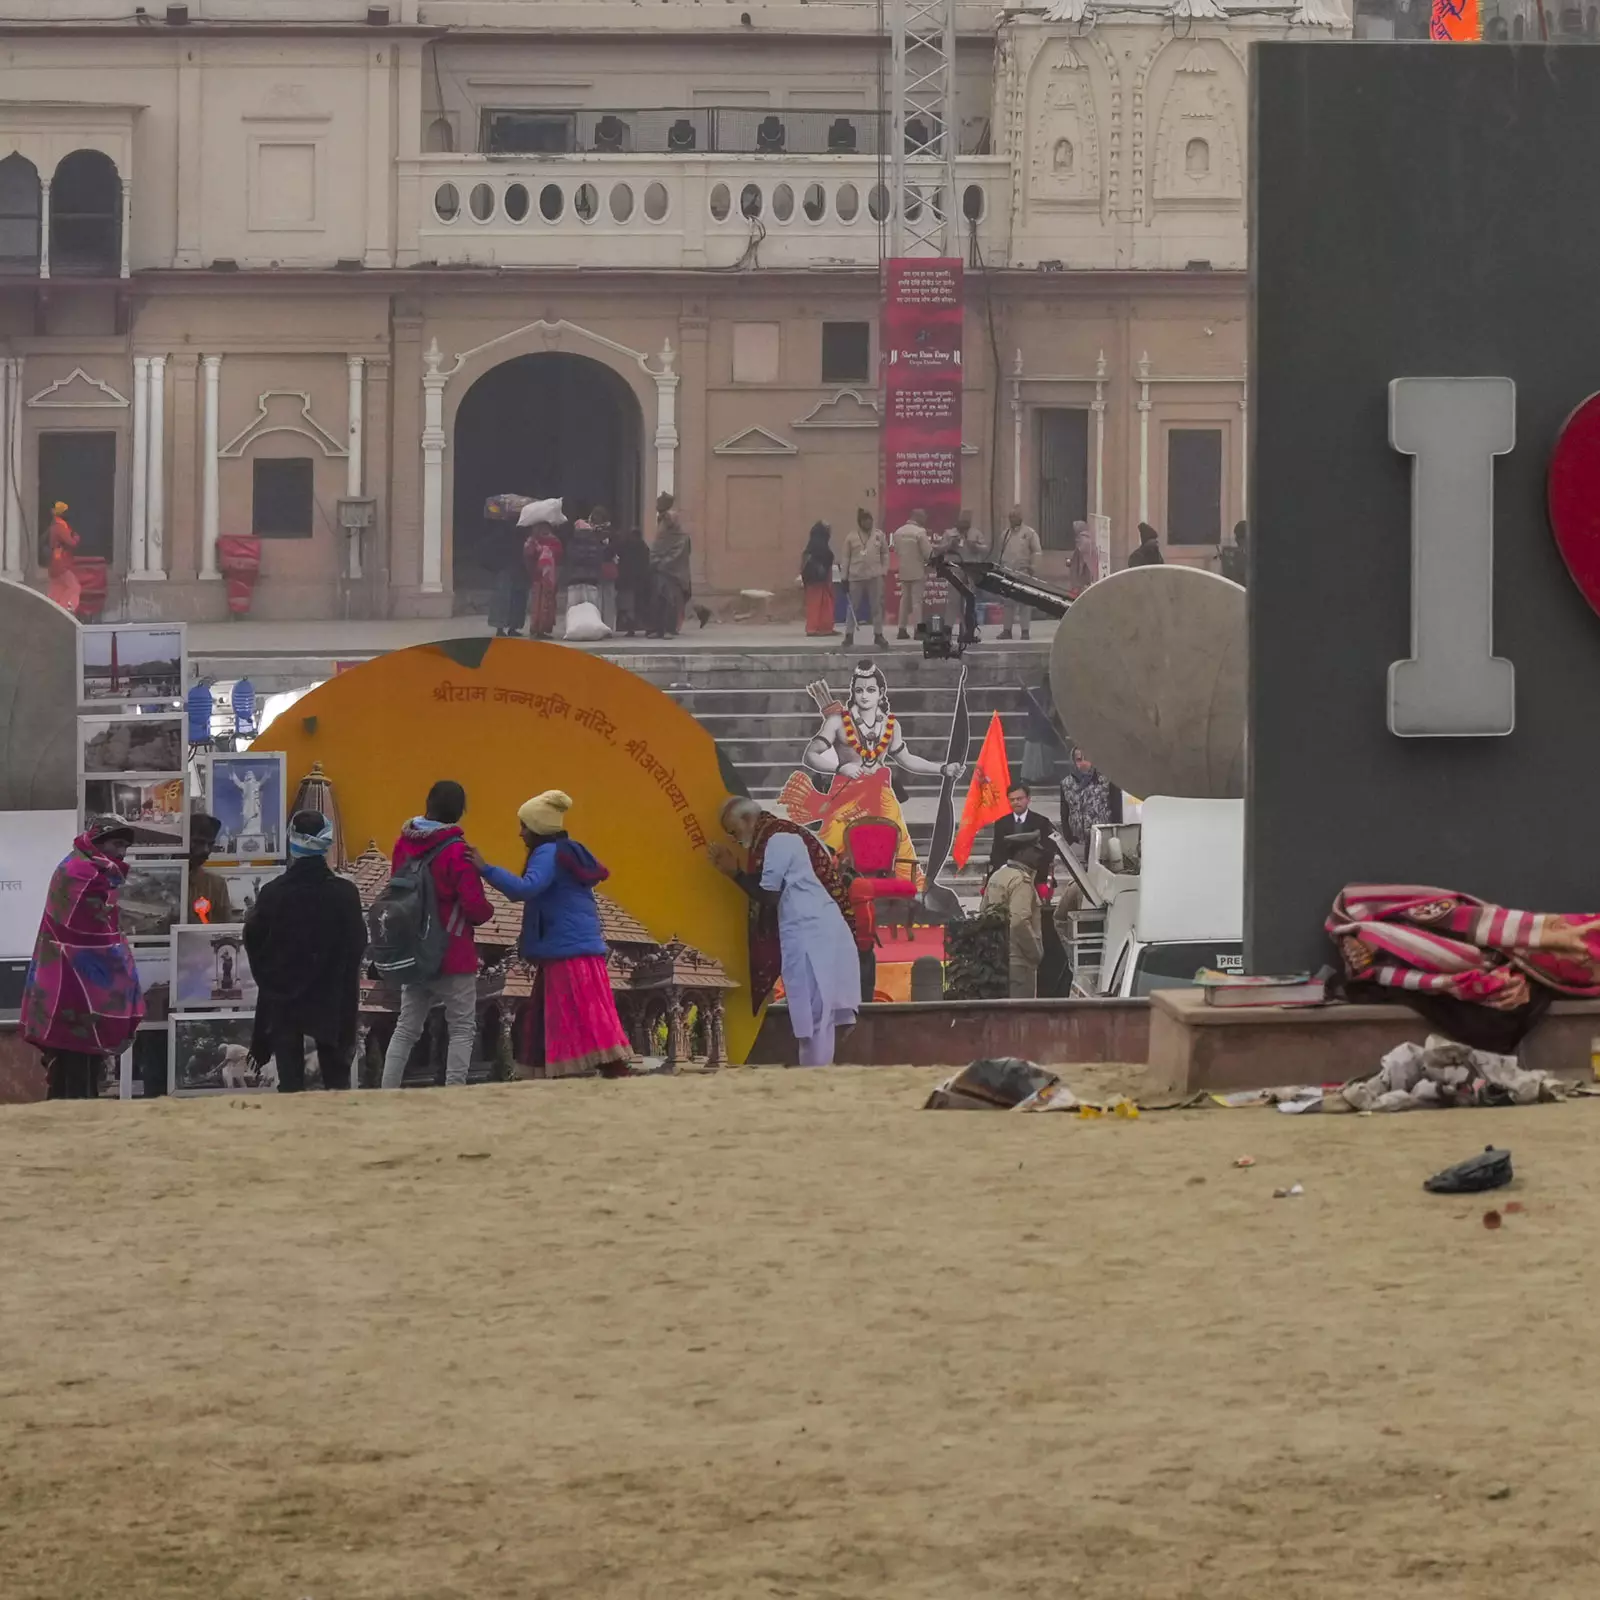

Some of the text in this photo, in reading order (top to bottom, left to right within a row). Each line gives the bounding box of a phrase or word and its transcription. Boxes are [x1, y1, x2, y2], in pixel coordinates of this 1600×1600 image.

[1388, 376, 1516, 738] I
[432, 680, 487, 702] श्रीराम
[493, 687, 572, 720] जन्मभूमि
[574, 708, 619, 747] मंदिर,
[681, 811, 707, 851] धाम
[1220, 957, 1243, 966] PRE
